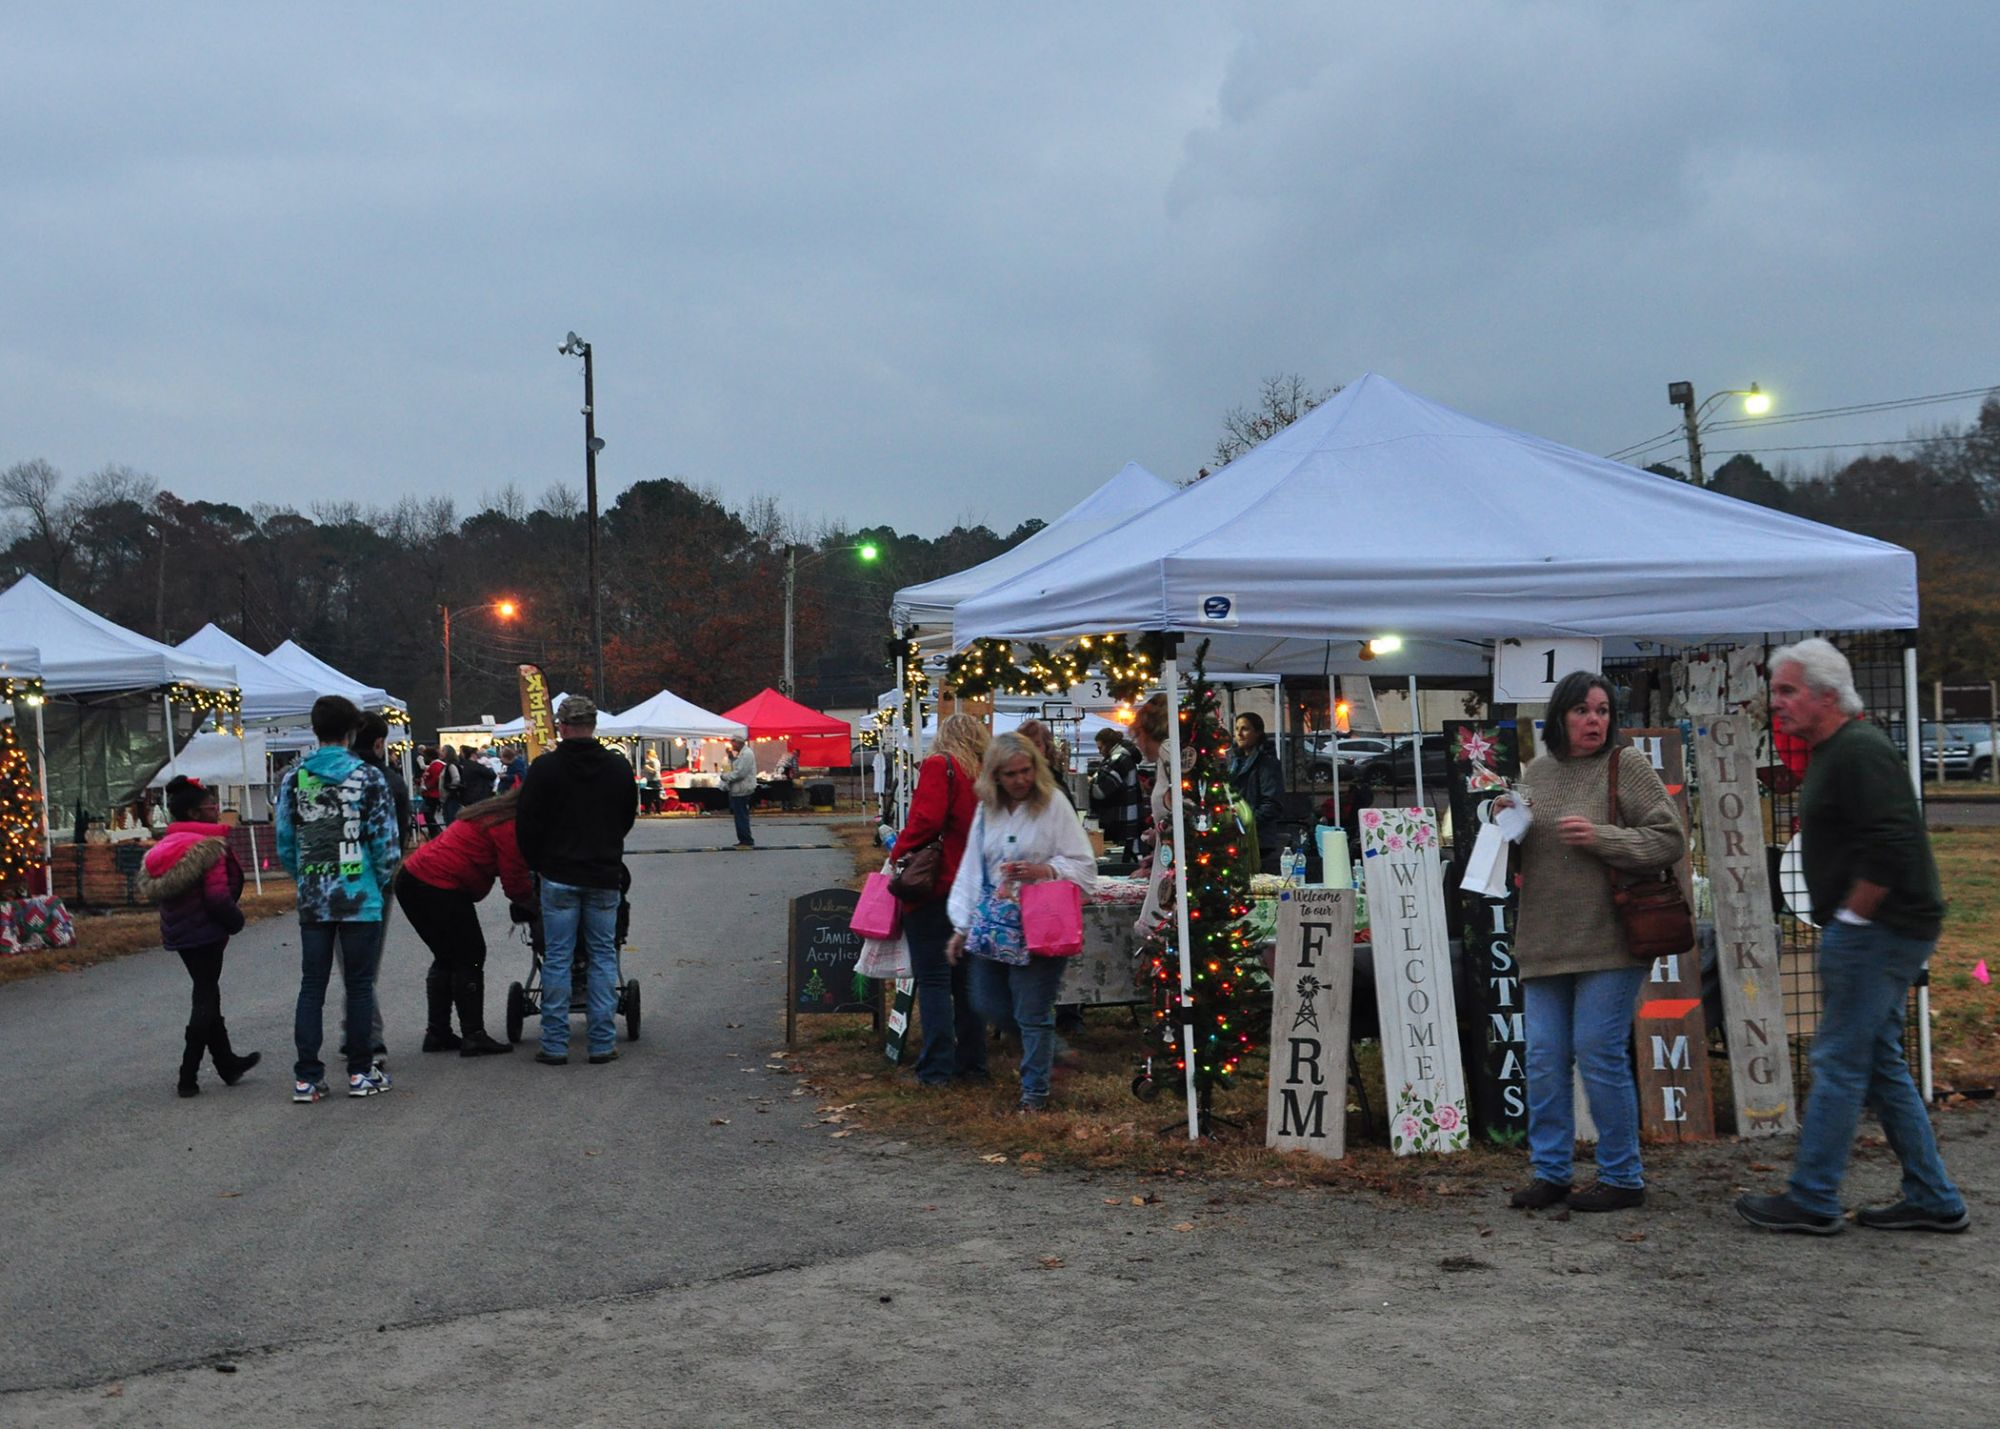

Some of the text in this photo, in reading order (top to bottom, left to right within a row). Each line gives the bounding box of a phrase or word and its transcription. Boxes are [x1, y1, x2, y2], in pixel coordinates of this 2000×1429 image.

[1541, 648, 1558, 683] 1
[1091, 682, 1102, 698] 3
[1710, 719, 1751, 894] GLORY
[1293, 889, 1341, 903] Welcome
[1300, 904, 1333, 917] to our
[806, 946, 858, 967] Acrylics
[1391, 862, 1437, 1081] WELCOME
[1733, 941, 1775, 1086] KNG
